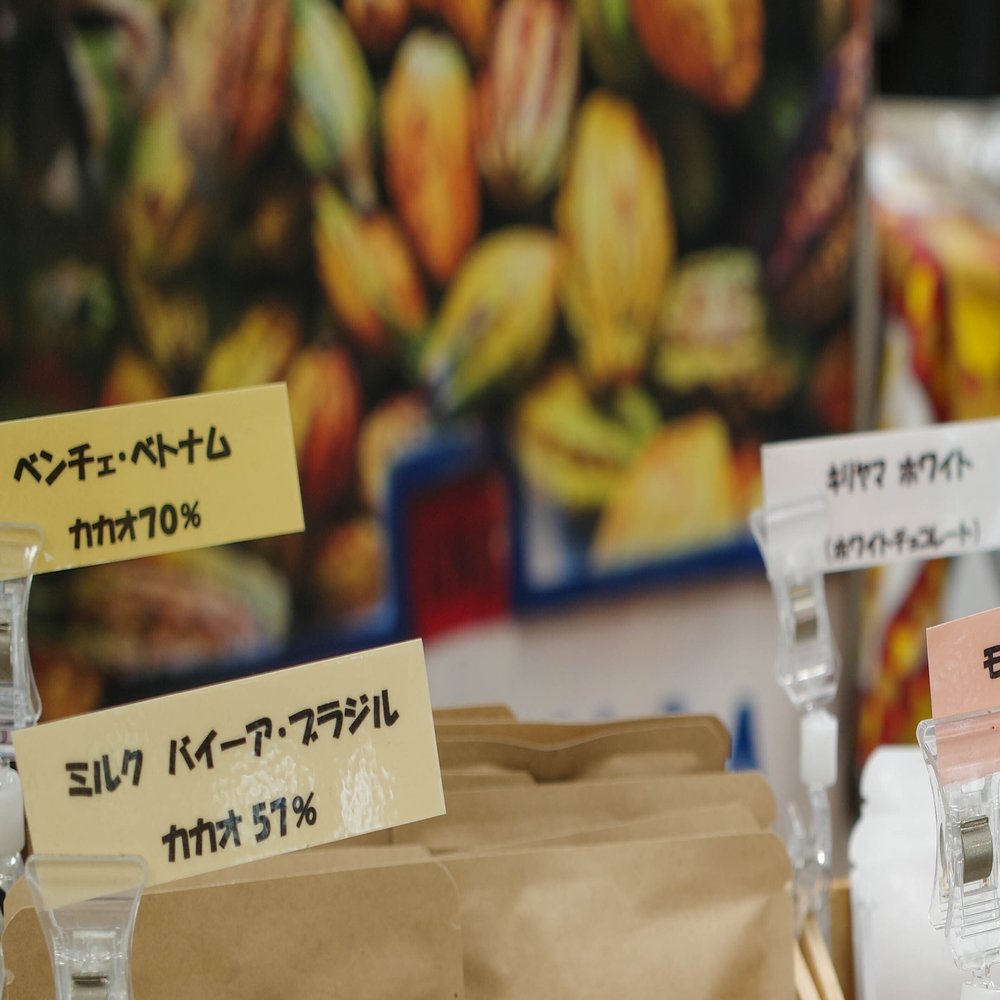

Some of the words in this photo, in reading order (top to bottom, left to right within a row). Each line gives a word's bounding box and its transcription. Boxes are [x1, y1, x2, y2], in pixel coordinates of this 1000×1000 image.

[14, 427, 231, 485] ベンチェ・ベトナム
[69, 502, 200, 549] カカオ70%
[66, 750, 143, 797] ミルク
[169, 690, 399, 775] バイーア・ブラジル
